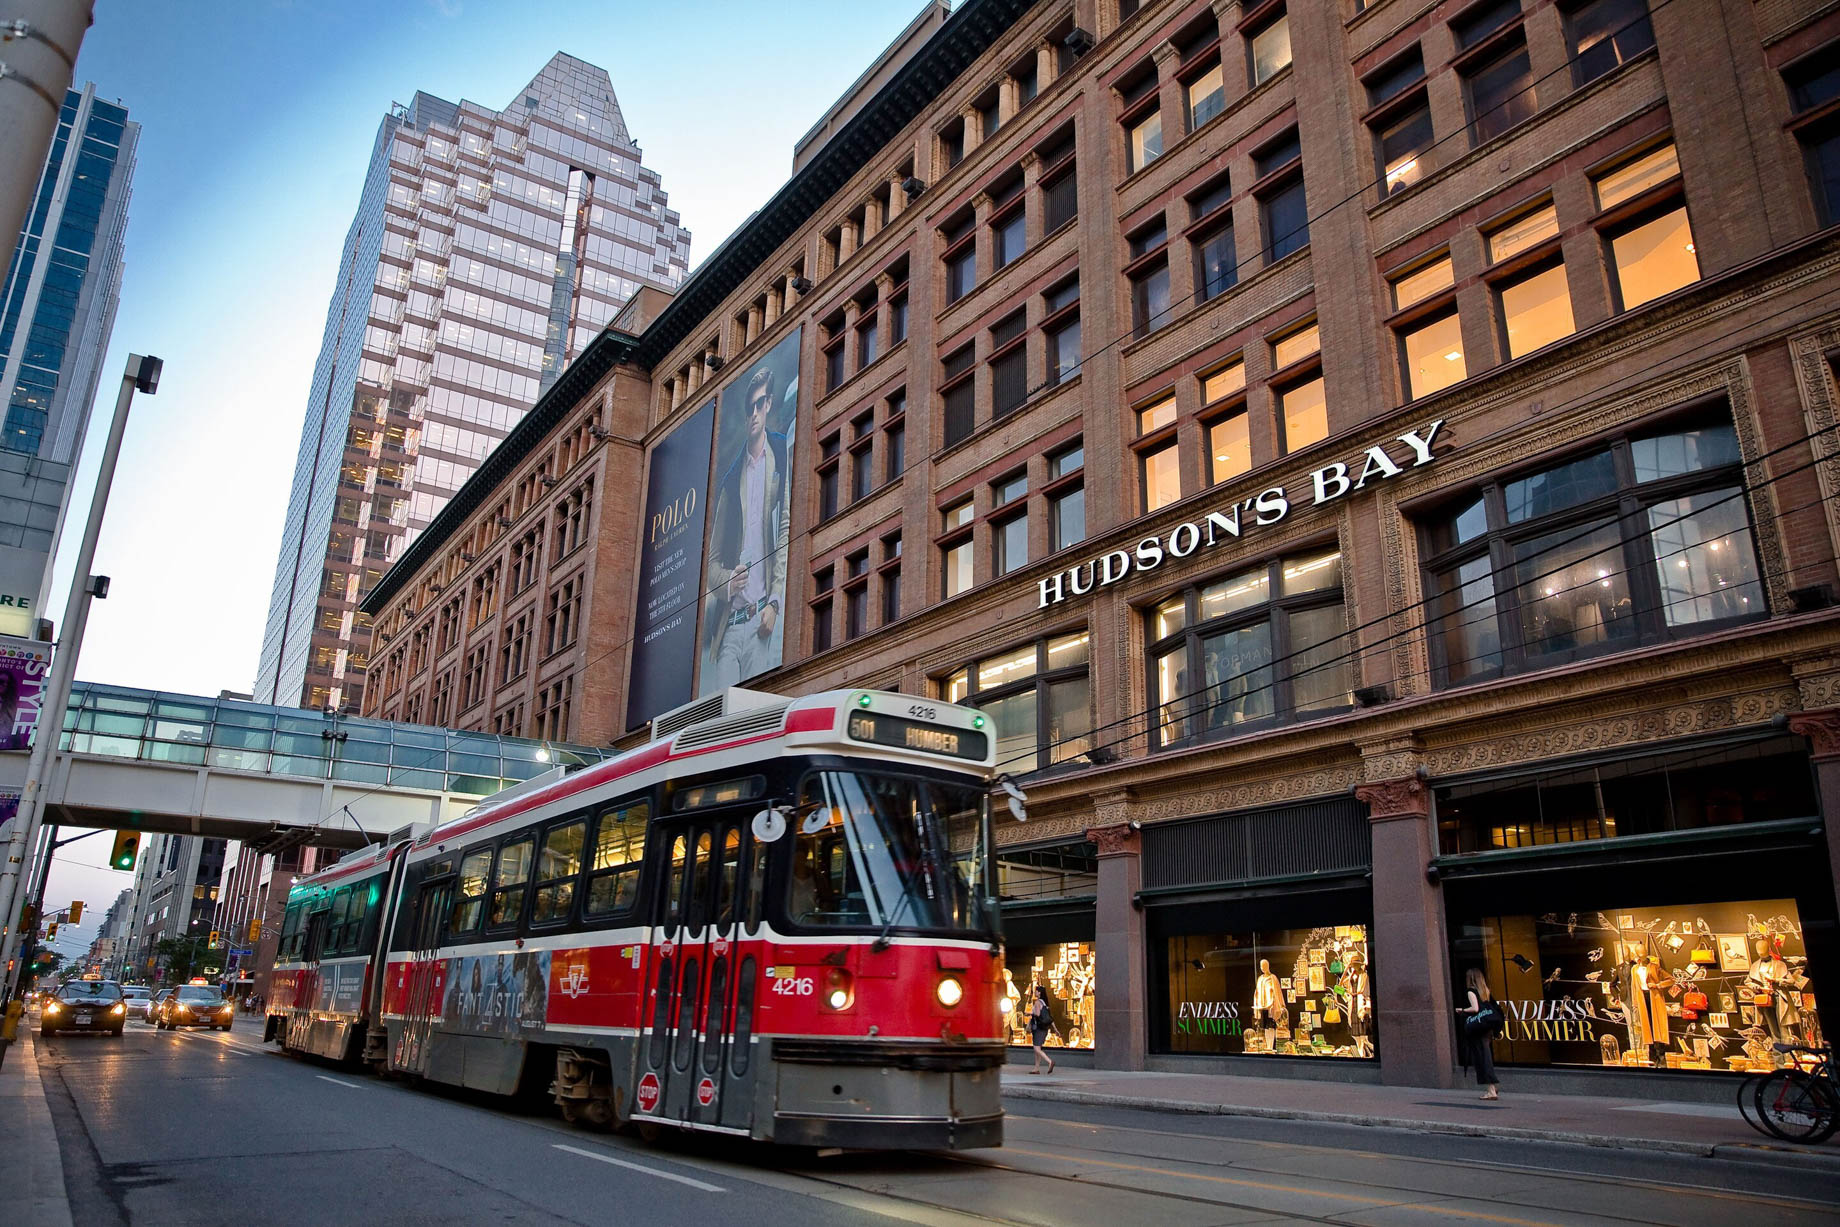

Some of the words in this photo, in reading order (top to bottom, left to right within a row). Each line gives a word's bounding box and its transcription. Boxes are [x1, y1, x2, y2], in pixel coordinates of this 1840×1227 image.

[651, 487, 696, 544] POLO
[1037, 487, 1288, 609] HUDSON'S
[1309, 420, 1443, 506] BAY
[650, 573, 661, 587] POLO
[0, 595, 30, 608] RE
[644, 623, 671, 644] HUDSON'S
[671, 615, 683, 629] BAY
[0, 657, 22, 665] NTO'S
[11, 660, 48, 735] STYLE
[907, 705, 937, 720] 4216
[850, 719, 876, 740] 501
[905, 727, 959, 754] HUMBER
[771, 977, 814, 996] 4216
[1178, 1001, 1239, 1019] ENDLESS
[1177, 1018, 1243, 1036] SUMMER
[640, 1085, 658, 1100] STOP
[700, 1086, 715, 1098] STOP
